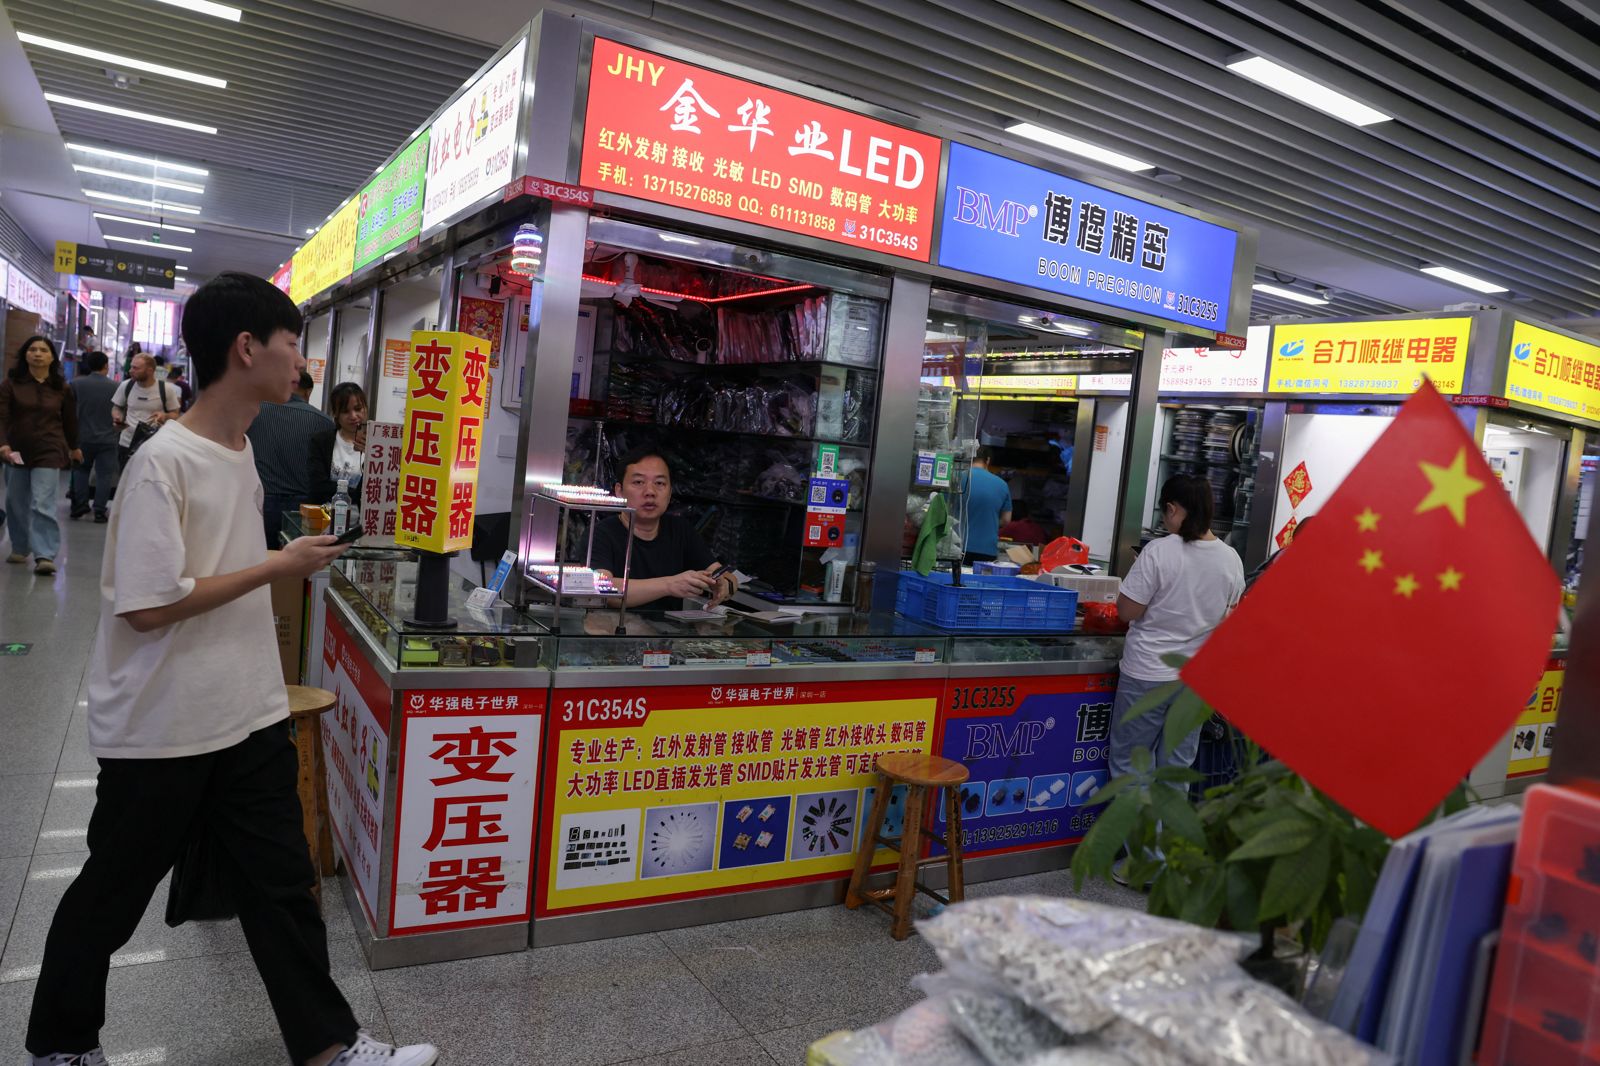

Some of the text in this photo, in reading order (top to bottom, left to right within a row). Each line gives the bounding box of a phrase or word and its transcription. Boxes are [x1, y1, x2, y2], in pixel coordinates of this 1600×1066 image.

[607, 53, 665, 87] JHY
[598, 127, 919, 225] 红外发射 接收 光敏 LED SMD 数码管 大功率
[542, 184, 589, 203] 31C354S
[643, 174, 732, 208] 13715276858
[770, 203, 836, 232] 611131858
[859, 225, 918, 251] 31C354S
[1043, 190, 1170, 272] 博穆精密
[58, 256, 72, 266] 1F
[1037, 257, 1163, 304] BOOM PRECISION
[1177, 294, 1218, 322] 31C325S
[1313, 336, 1457, 364] 合力顺继电器
[400, 339, 452, 537] 变压器
[449, 346, 487, 540] 变压器
[429, 695, 519, 711] 华强电子世界
[562, 697, 647, 722] 31C354S
[726, 686, 795, 701] 华强电子世界
[951, 686, 1016, 710] 31C325S
[652, 731, 728, 760] 红外发射管
[731, 729, 773, 754] 接收管
[780, 727, 821, 752] 光敏管
[824, 722, 887, 748] 红外接收头
[890, 721, 926, 744] 数码管
[567, 770, 618, 799] 大功率
[623, 762, 733, 793] LED直插发光管
[737, 754, 842, 783] SMD贴片发光管
[418, 725, 517, 916] 变压器
